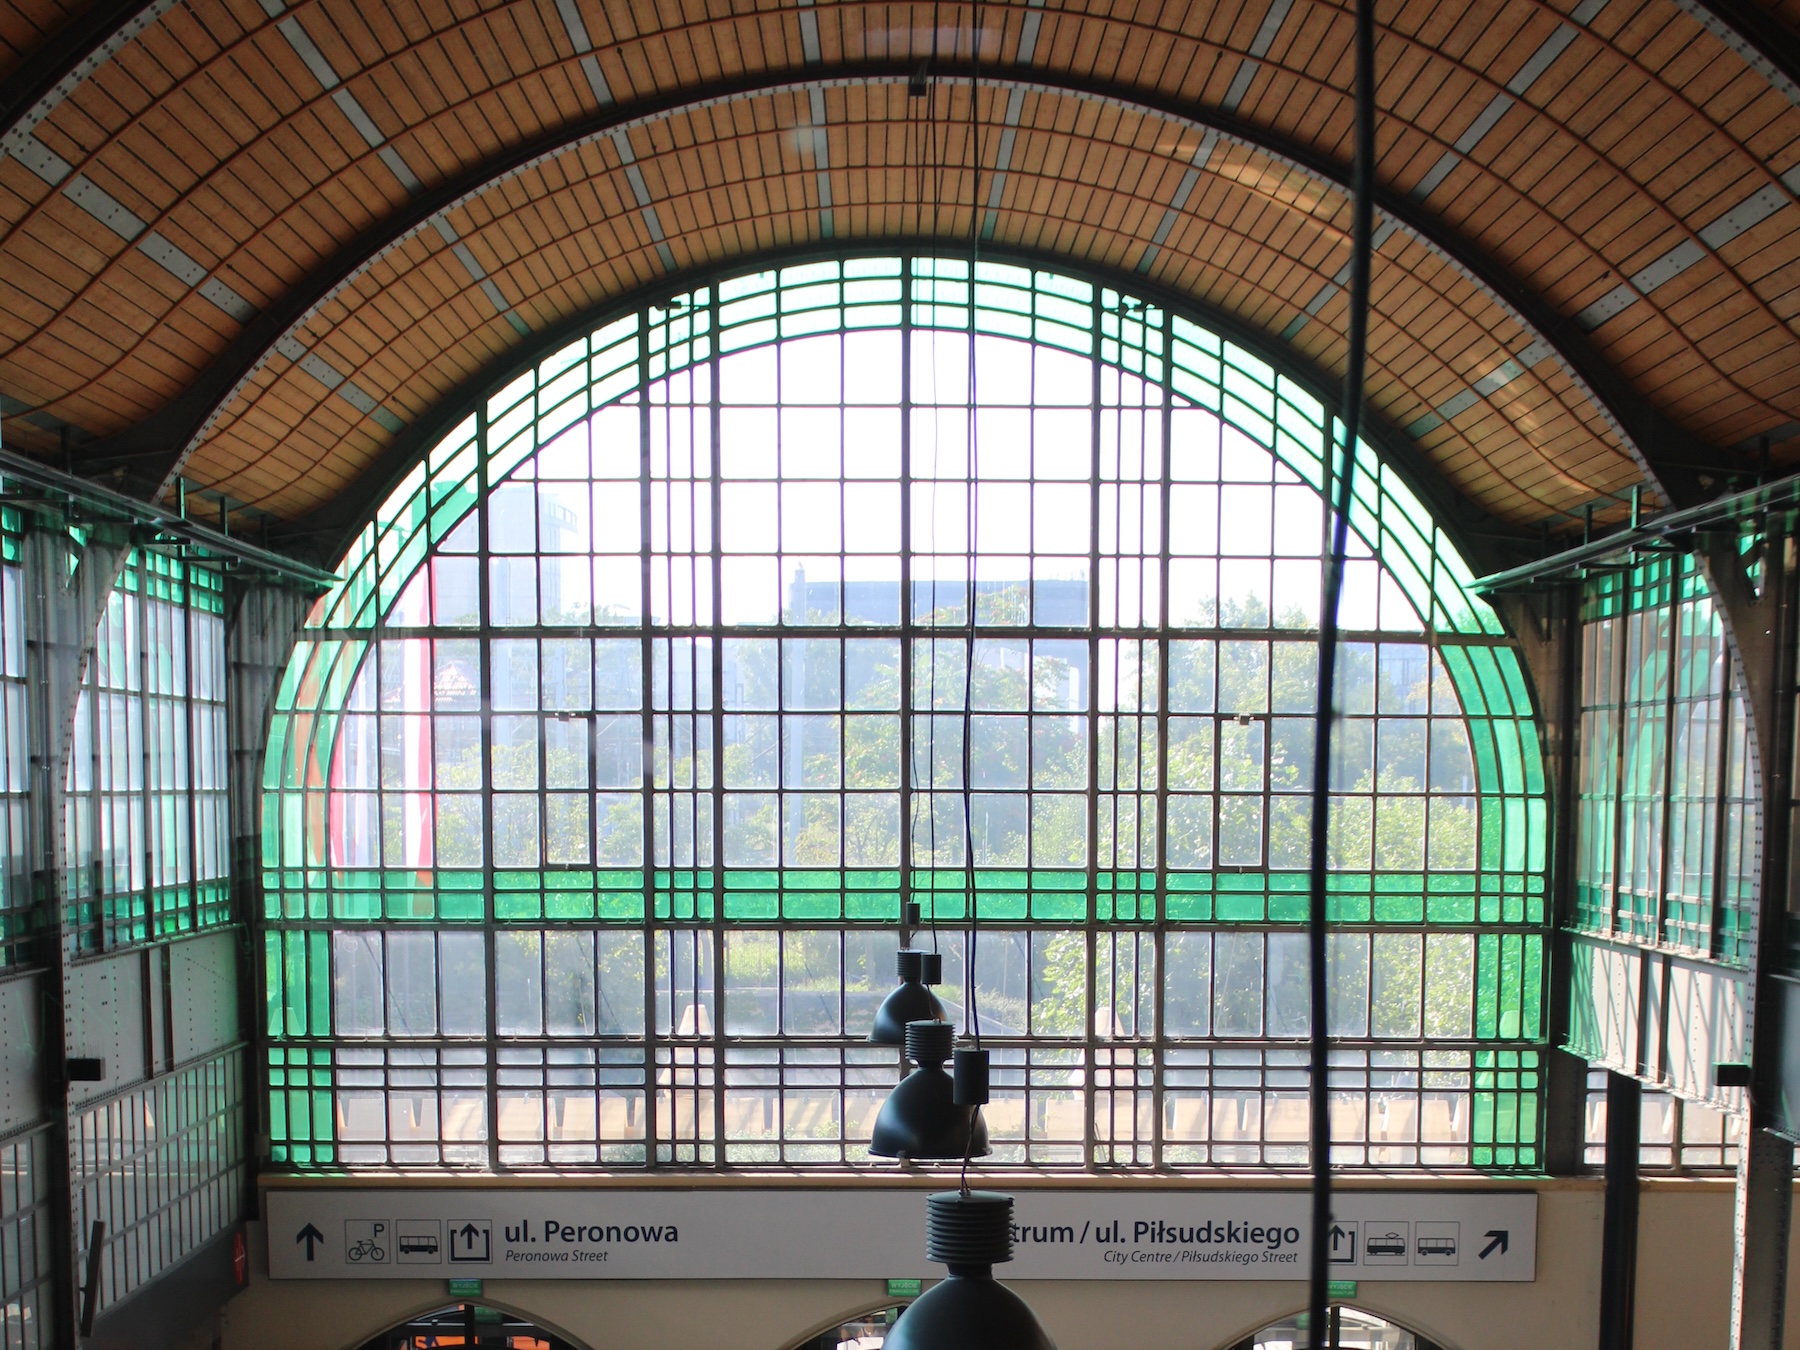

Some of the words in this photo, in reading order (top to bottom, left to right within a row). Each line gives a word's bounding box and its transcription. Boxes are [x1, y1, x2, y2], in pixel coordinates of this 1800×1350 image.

[374, 1223, 385, 1238] P
[505, 1219, 536, 1243] ul.
[544, 1220, 679, 1243] Peronowa
[1013, 1222, 1074, 1243] trum
[1095, 1220, 1126, 1243] ul.
[1134, 1220, 1300, 1250] Piłsudskiego
[505, 1249, 569, 1262] Peronowa
[571, 1249, 609, 1262] Street
[1103, 1251, 1129, 1266] City
[1131, 1251, 1172, 1263] Centre
[1181, 1250, 1259, 1266] Piłsudskiego
[1261, 1250, 1298, 1263] Street
